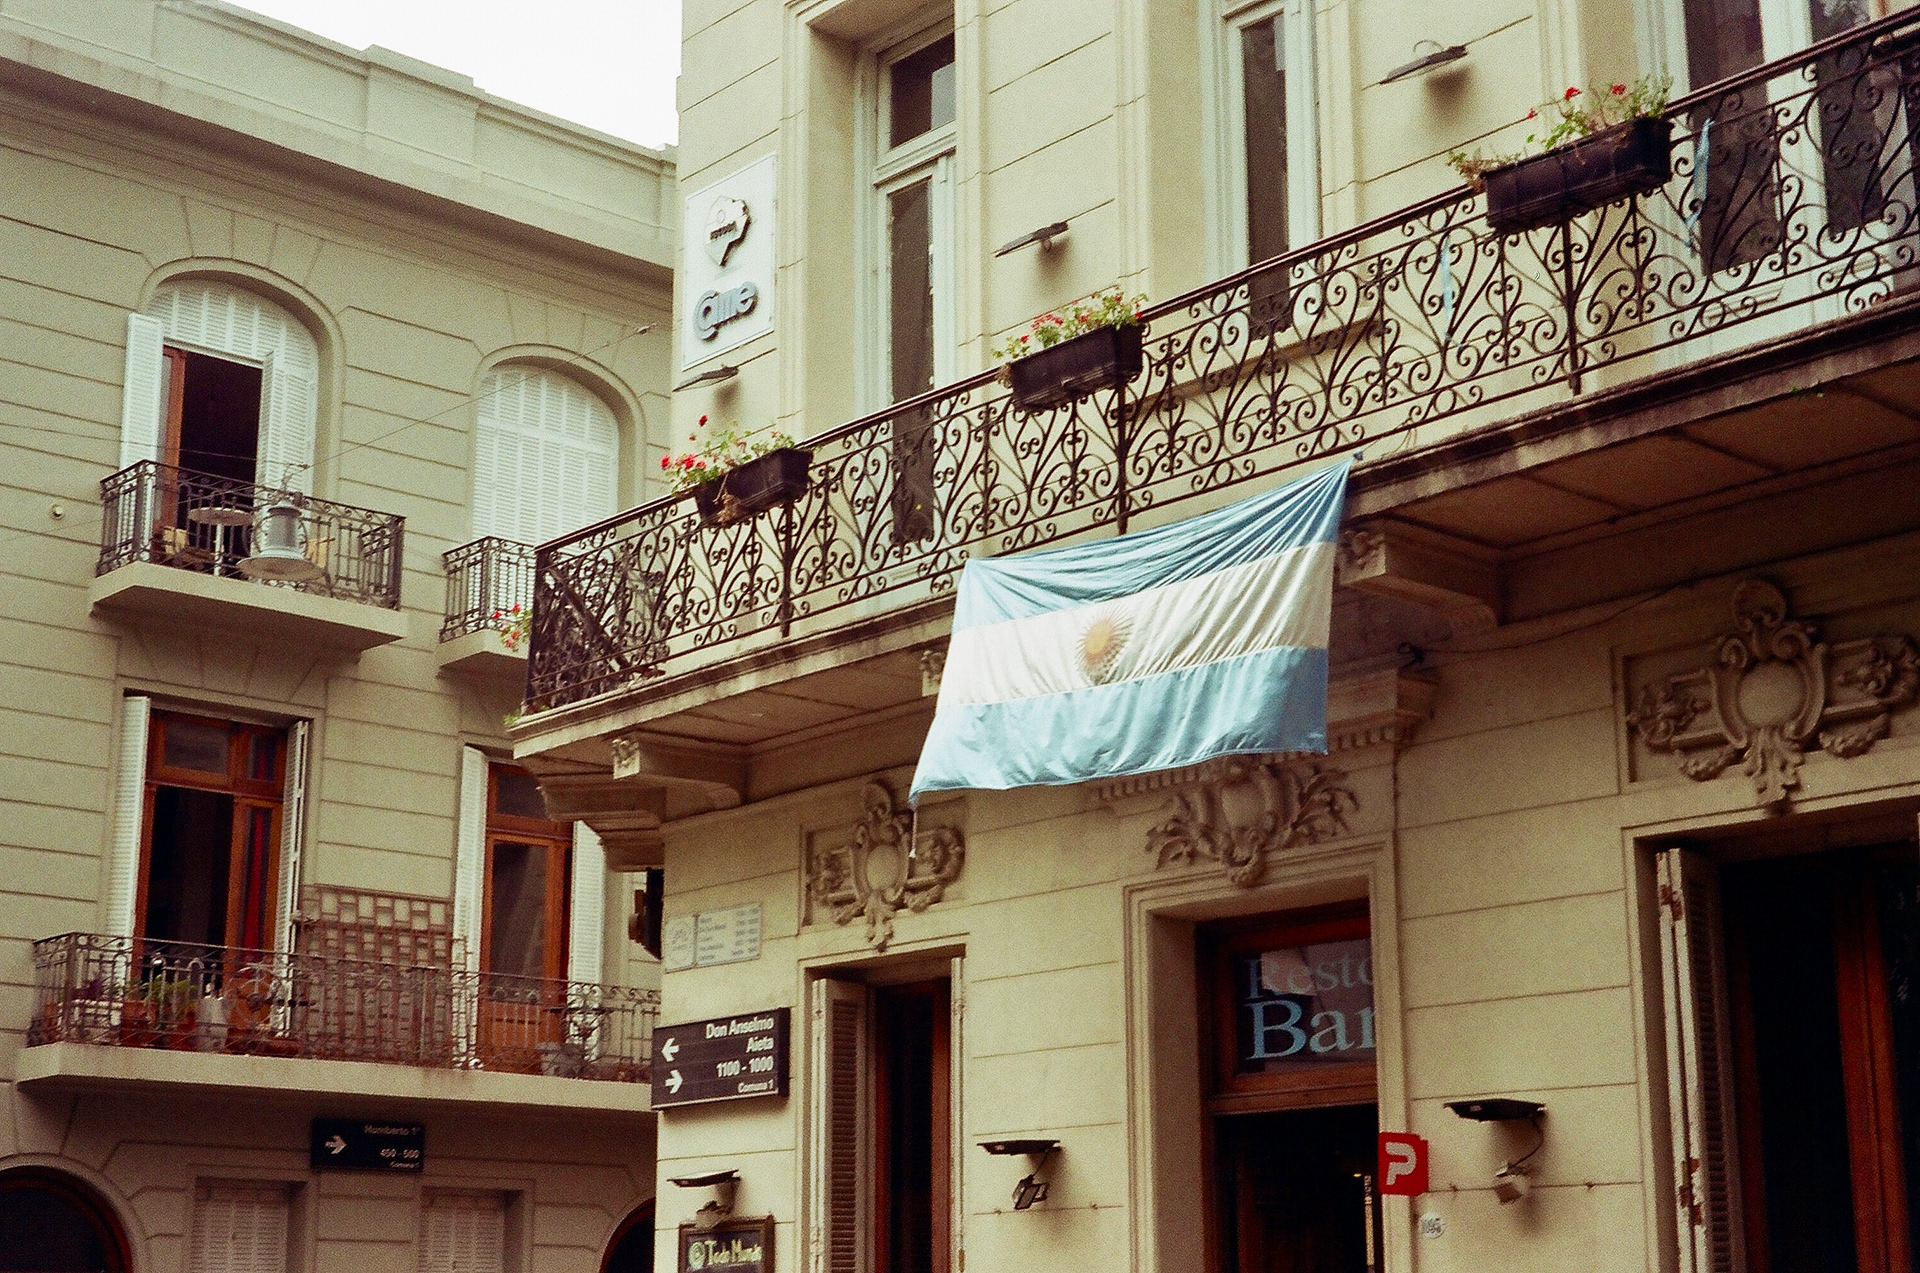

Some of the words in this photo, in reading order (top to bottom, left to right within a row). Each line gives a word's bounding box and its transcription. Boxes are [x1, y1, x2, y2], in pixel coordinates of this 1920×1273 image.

[705, 1023, 728, 1039] Don
[728, 1016, 774, 1036] Anselmo
[1244, 1000, 1377, 1060] Bar
[746, 1036, 774, 1053] Aieta
[716, 1060, 740, 1078] 1100
[749, 1055, 774, 1073] 1000
[768, 1078, 774, 1090] 1
